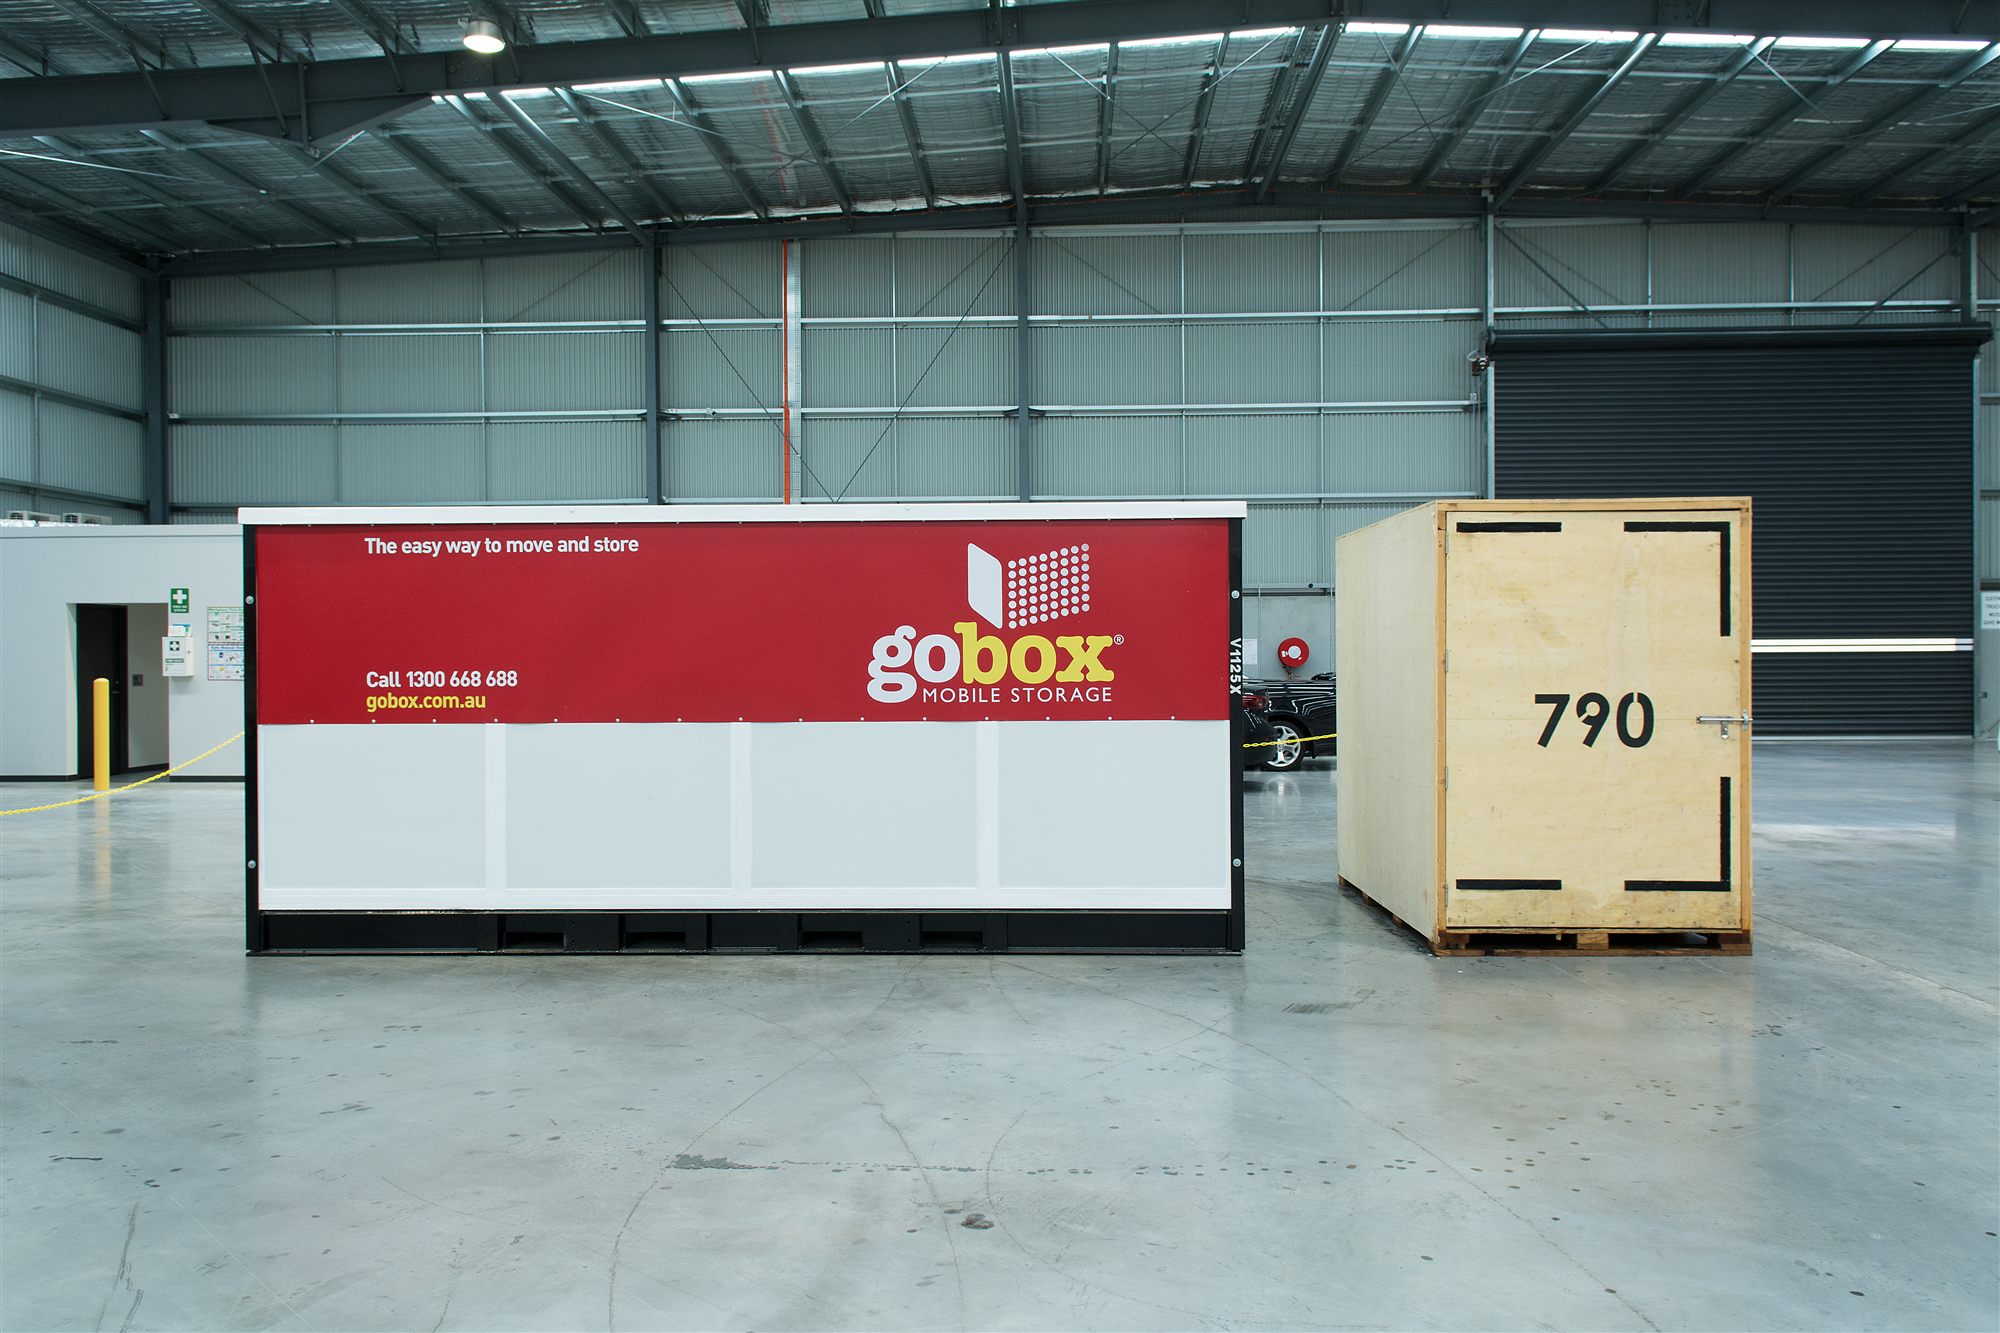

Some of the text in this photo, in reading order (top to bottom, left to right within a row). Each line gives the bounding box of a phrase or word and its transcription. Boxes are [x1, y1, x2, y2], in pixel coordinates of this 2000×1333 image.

[364, 536, 640, 557] The easy way to move and store
[1229, 637, 1242, 695] V1125X
[366, 670, 518, 687] Call 1300 668 688
[366, 692, 487, 712] gobox.com.au
[922, 687, 1112, 702] MOBILE STORAGE
[1534, 692, 1655, 748] 790
